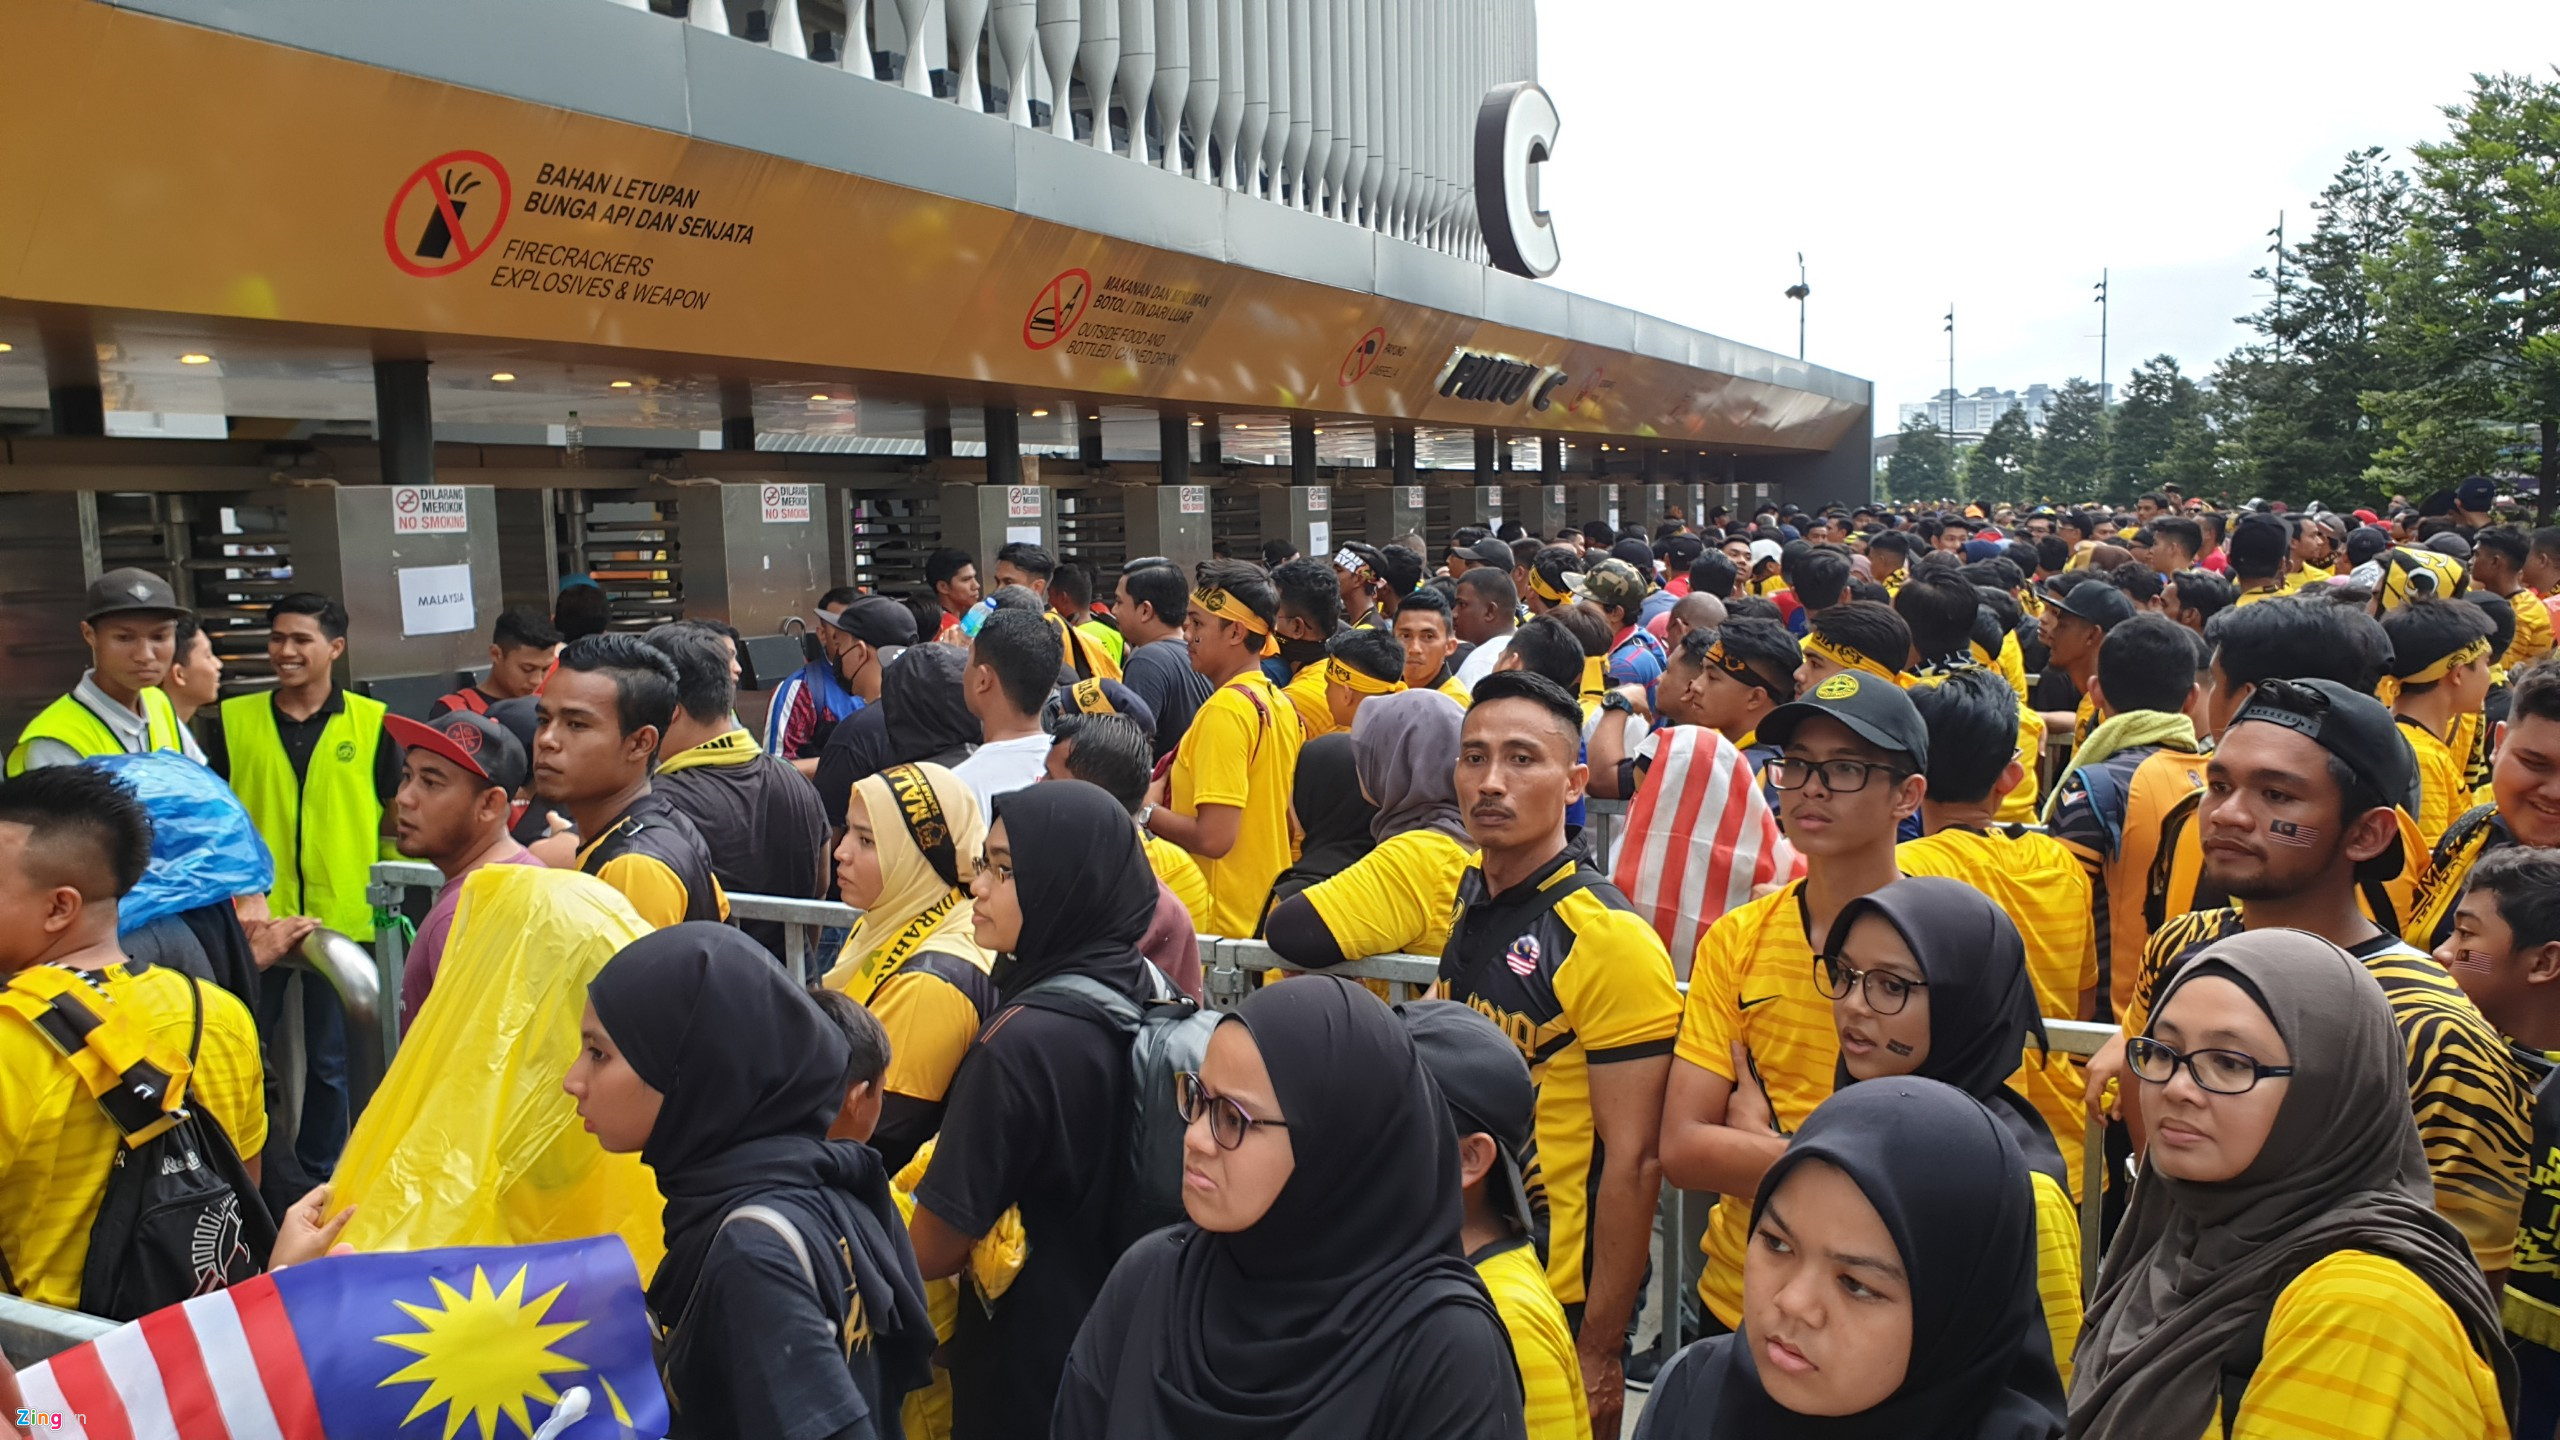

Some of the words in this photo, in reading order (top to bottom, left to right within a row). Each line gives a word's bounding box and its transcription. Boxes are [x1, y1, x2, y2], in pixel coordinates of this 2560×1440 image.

[536, 163, 612, 194] BAHAN
[612, 177, 700, 209] LETUPAN
[1477, 80, 1561, 279] C
[524, 191, 597, 222] BUNGA
[599, 204, 636, 226] API
[636, 210, 677, 235] DAN
[678, 216, 754, 245] SENJATA
[502, 239, 654, 277] FIRECRACKERS
[491, 266, 612, 299] EXPLOSIVES
[614, 282, 628, 300] &
[633, 284, 710, 310] WEAPON
[1103, 275, 1152, 298] MAKANAN
[1153, 285, 1171, 300] DAN
[1093, 294, 1125, 313] BOTOL
[1132, 302, 1147, 316] TIN
[1077, 322, 1121, 342] OUTSIDE
[1121, 329, 1149, 344] FOOD
[1147, 333, 1166, 347] AND
[1066, 340, 1110, 359] BOTTLED
[420, 488, 463, 500] DILARANG
[422, 502, 464, 514] MEROKOK
[765, 508, 778, 519] NO
[399, 516, 417, 529] NO
[421, 516, 465, 529] SMOKING
[418, 592, 465, 607] MALAYSIA
[883, 766, 932, 825] MALA
